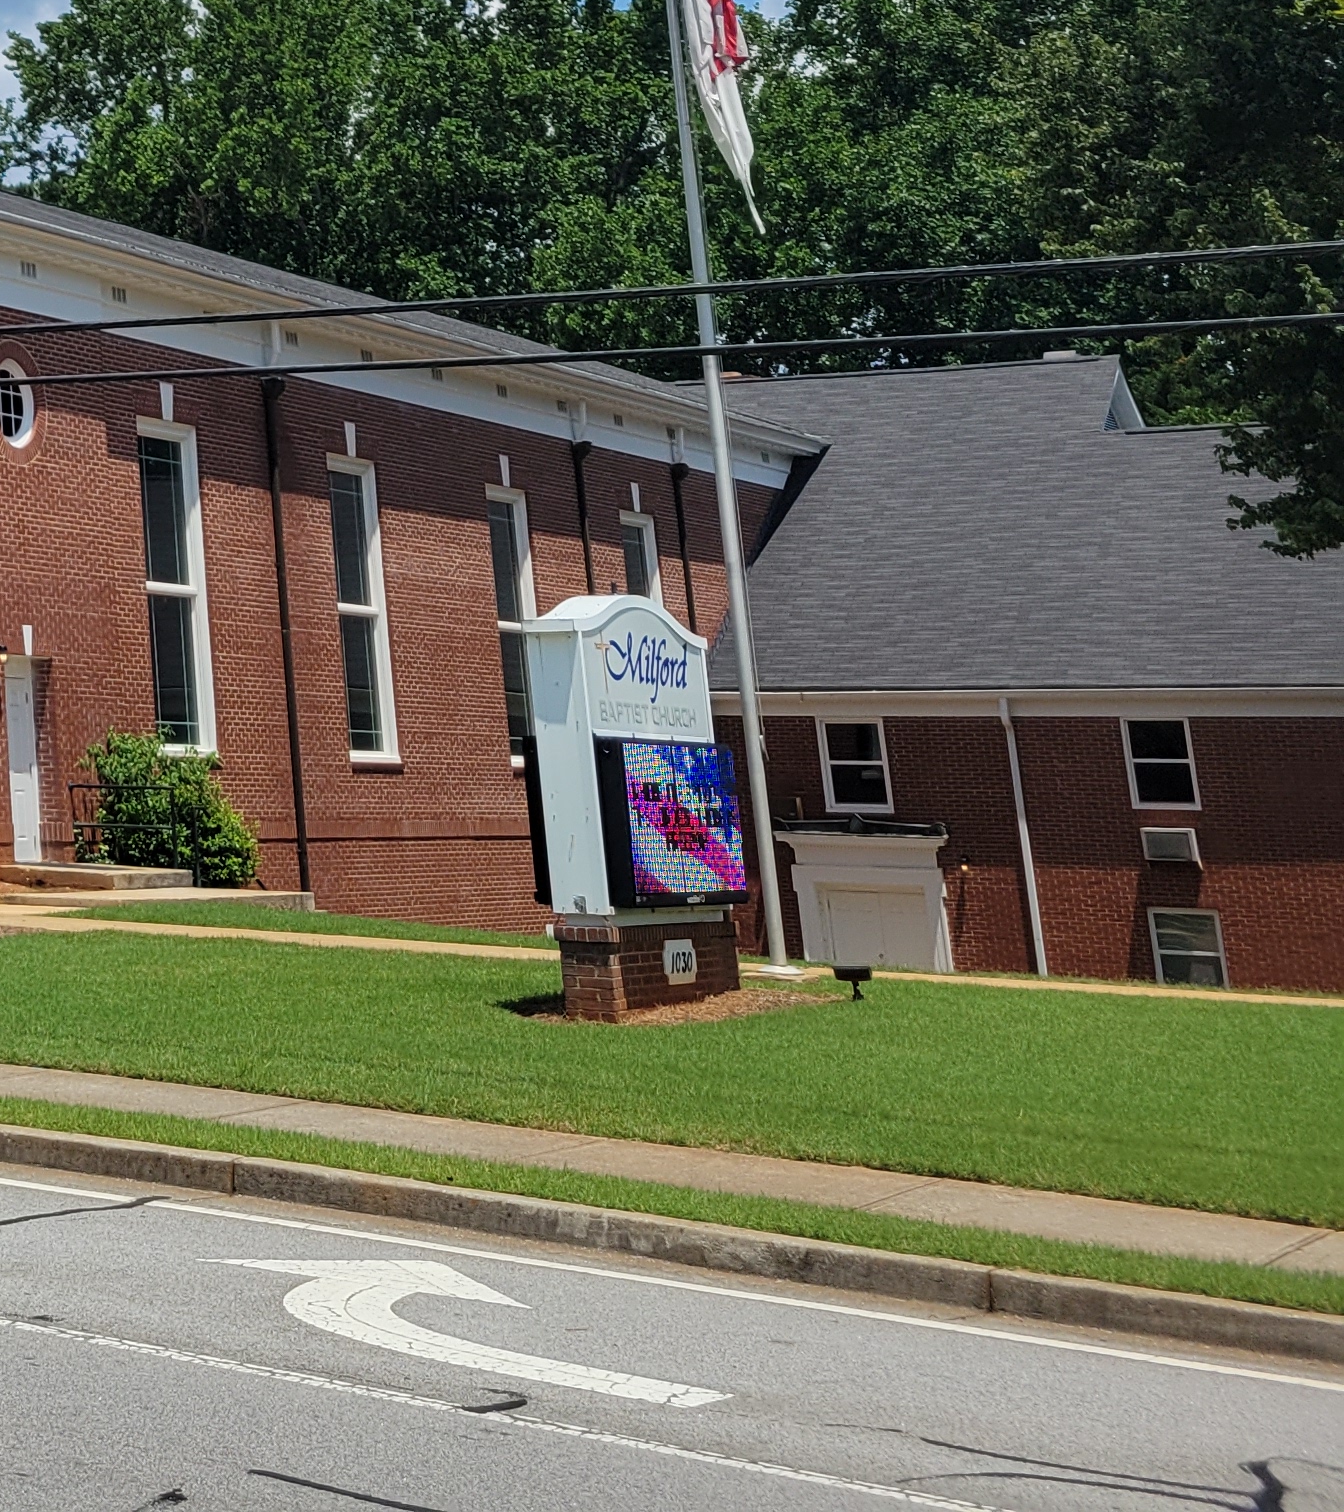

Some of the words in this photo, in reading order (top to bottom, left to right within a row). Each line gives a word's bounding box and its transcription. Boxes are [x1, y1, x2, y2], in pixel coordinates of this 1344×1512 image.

[605, 632, 688, 704] Milford
[599, 699, 649, 724] BAPTIST
[651, 707, 697, 728] CHURCH
[670, 951, 693, 974] 1030
